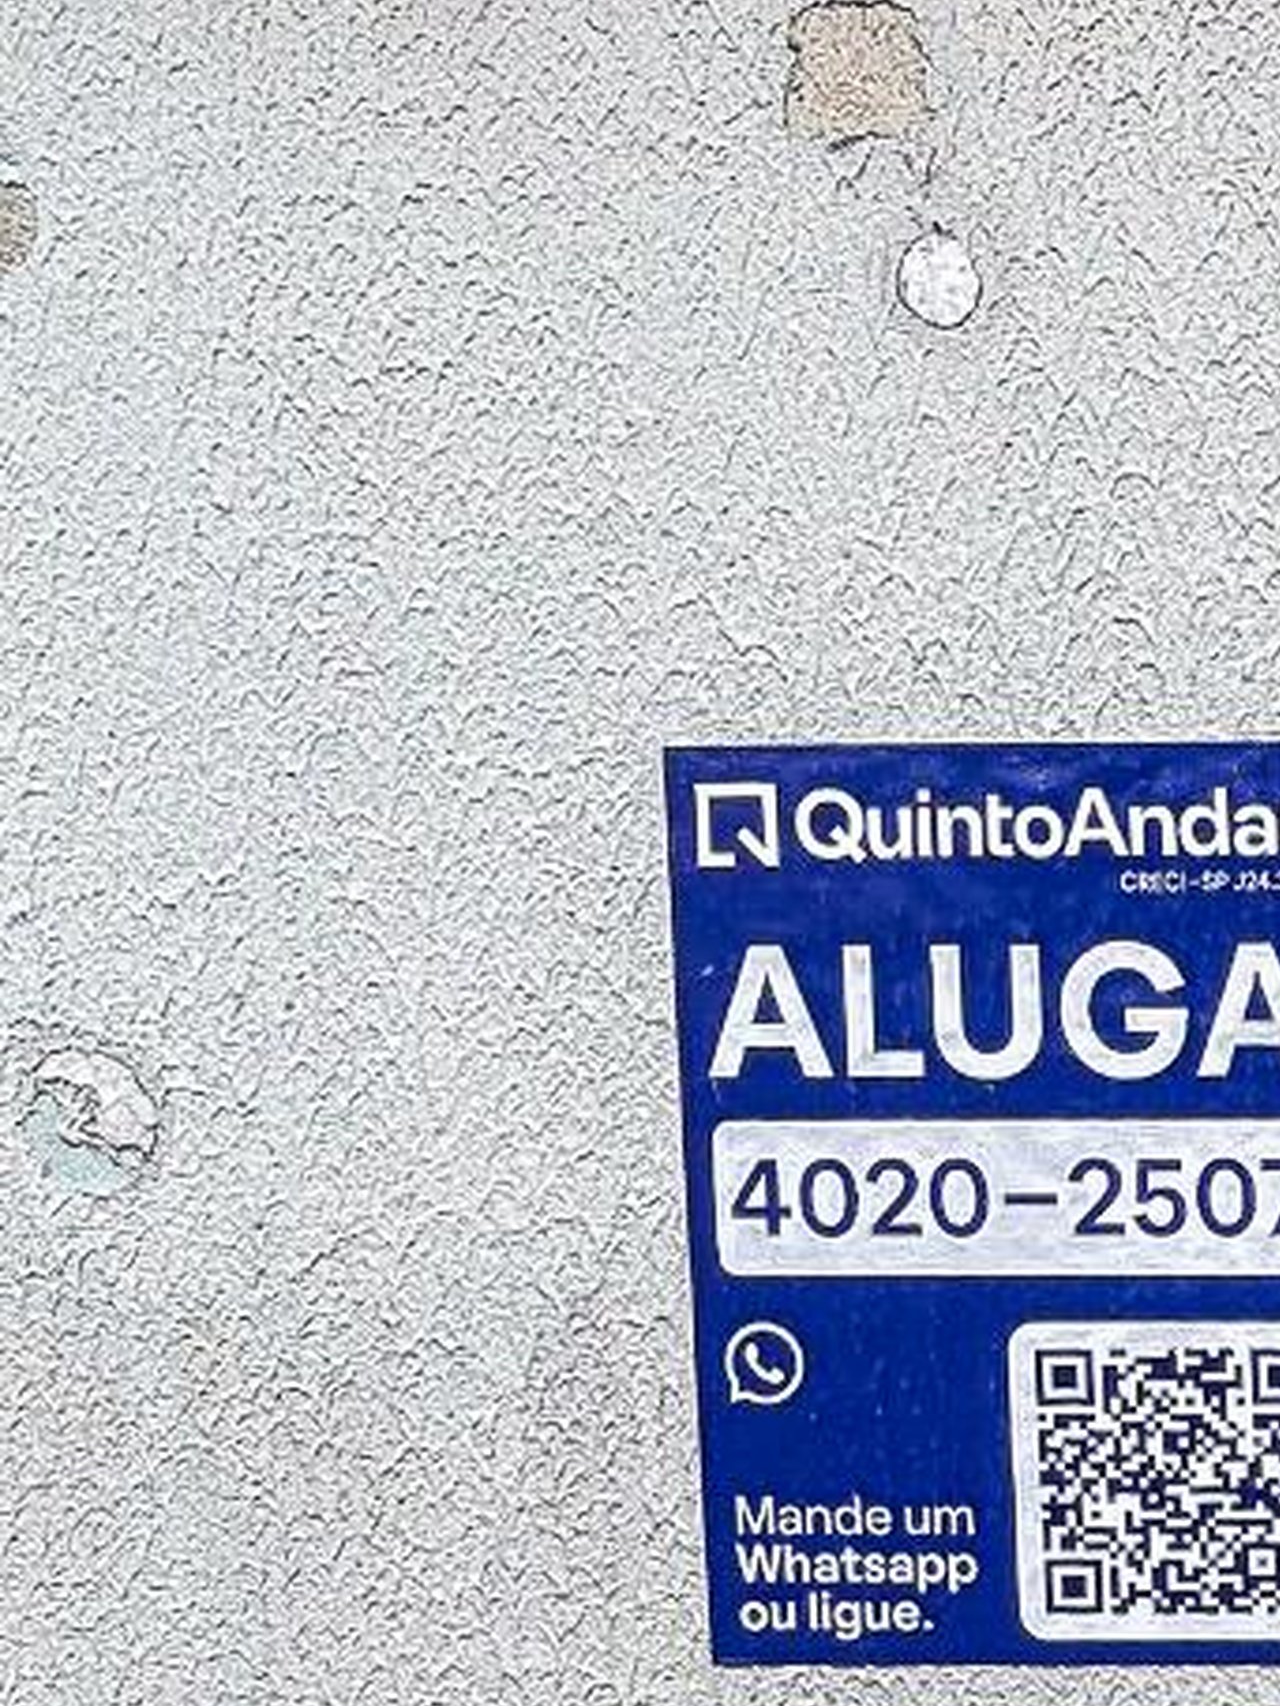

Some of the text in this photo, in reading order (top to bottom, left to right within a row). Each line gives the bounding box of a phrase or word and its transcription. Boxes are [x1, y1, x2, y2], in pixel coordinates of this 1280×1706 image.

[734, 1491, 977, 1536] Mande um
[734, 1543, 979, 1594] Whatsapp
[739, 1591, 936, 1641] ou ligue.
